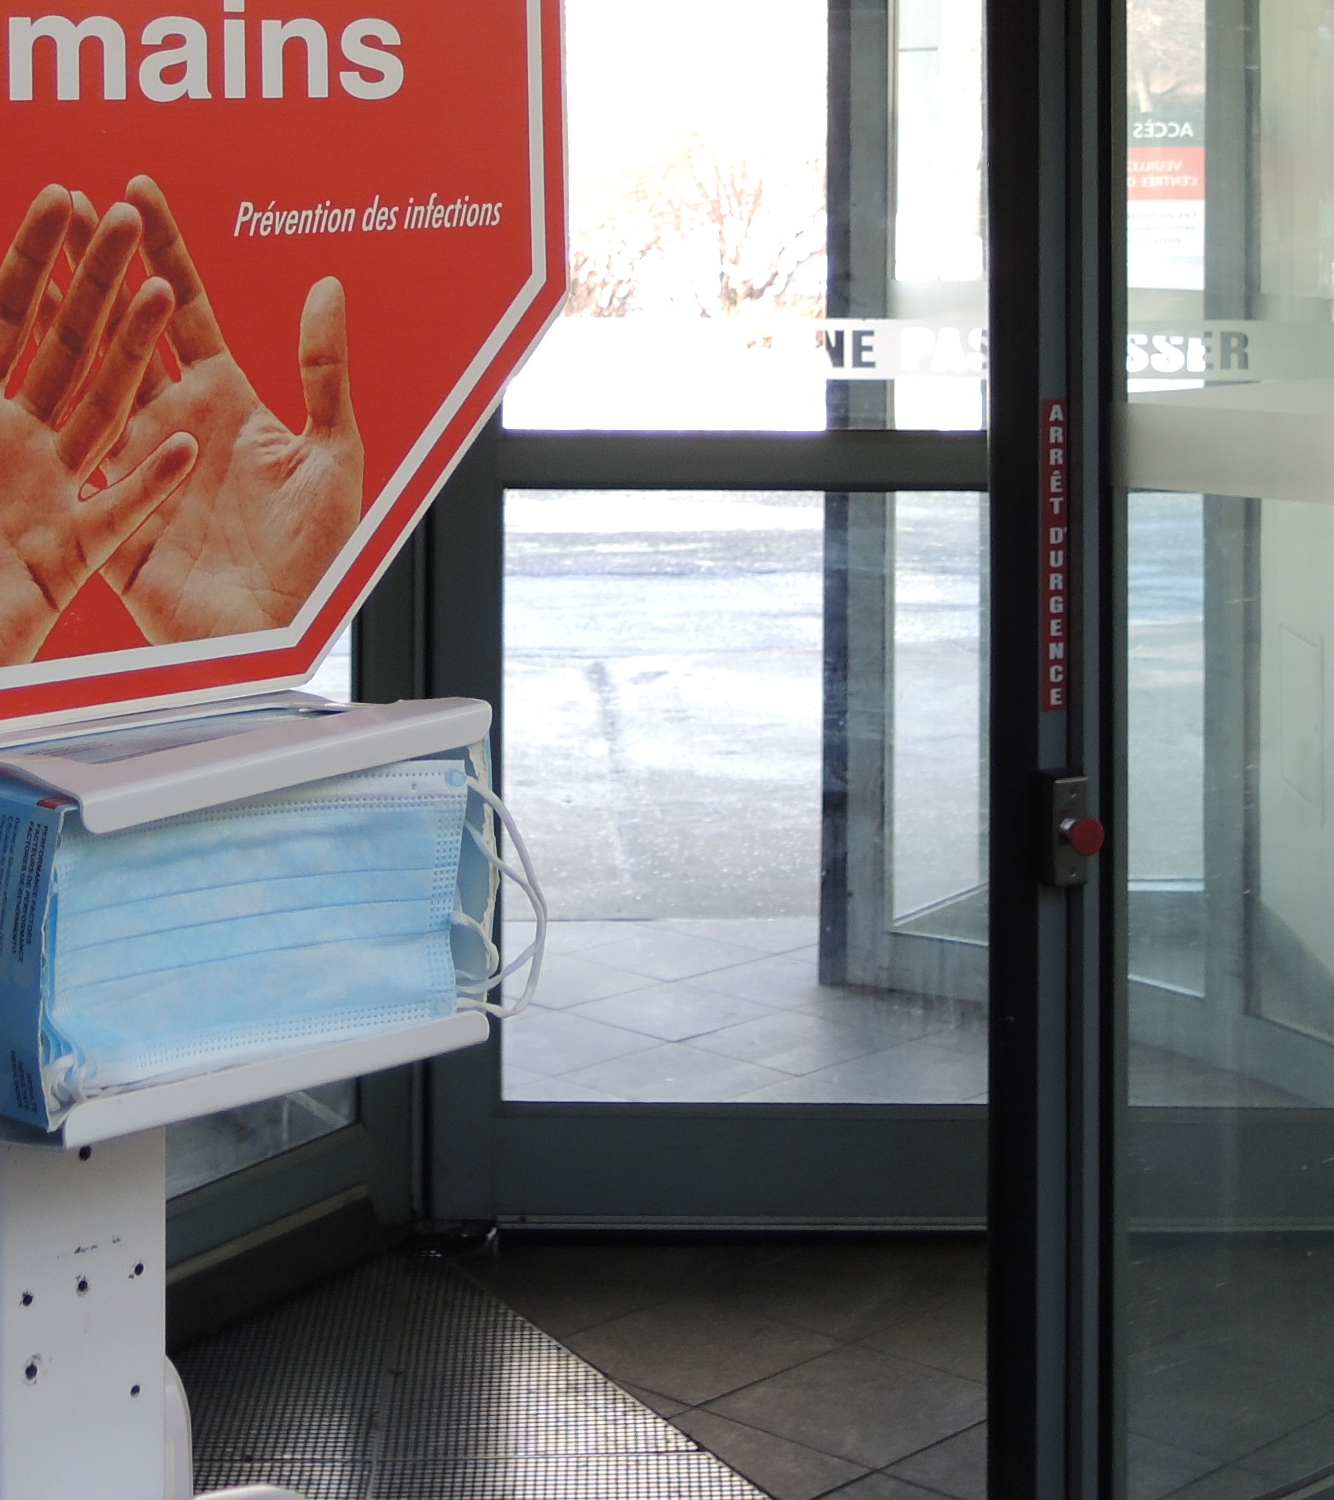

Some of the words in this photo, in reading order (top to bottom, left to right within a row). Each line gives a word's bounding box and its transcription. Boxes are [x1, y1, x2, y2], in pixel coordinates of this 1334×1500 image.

[234, 201, 356, 237] Prévention
[362, 194, 399, 232] des
[403, 192, 503, 230] infections
[816, 329, 877, 369] NE
[1048, 404, 1064, 515] ARRÊT
